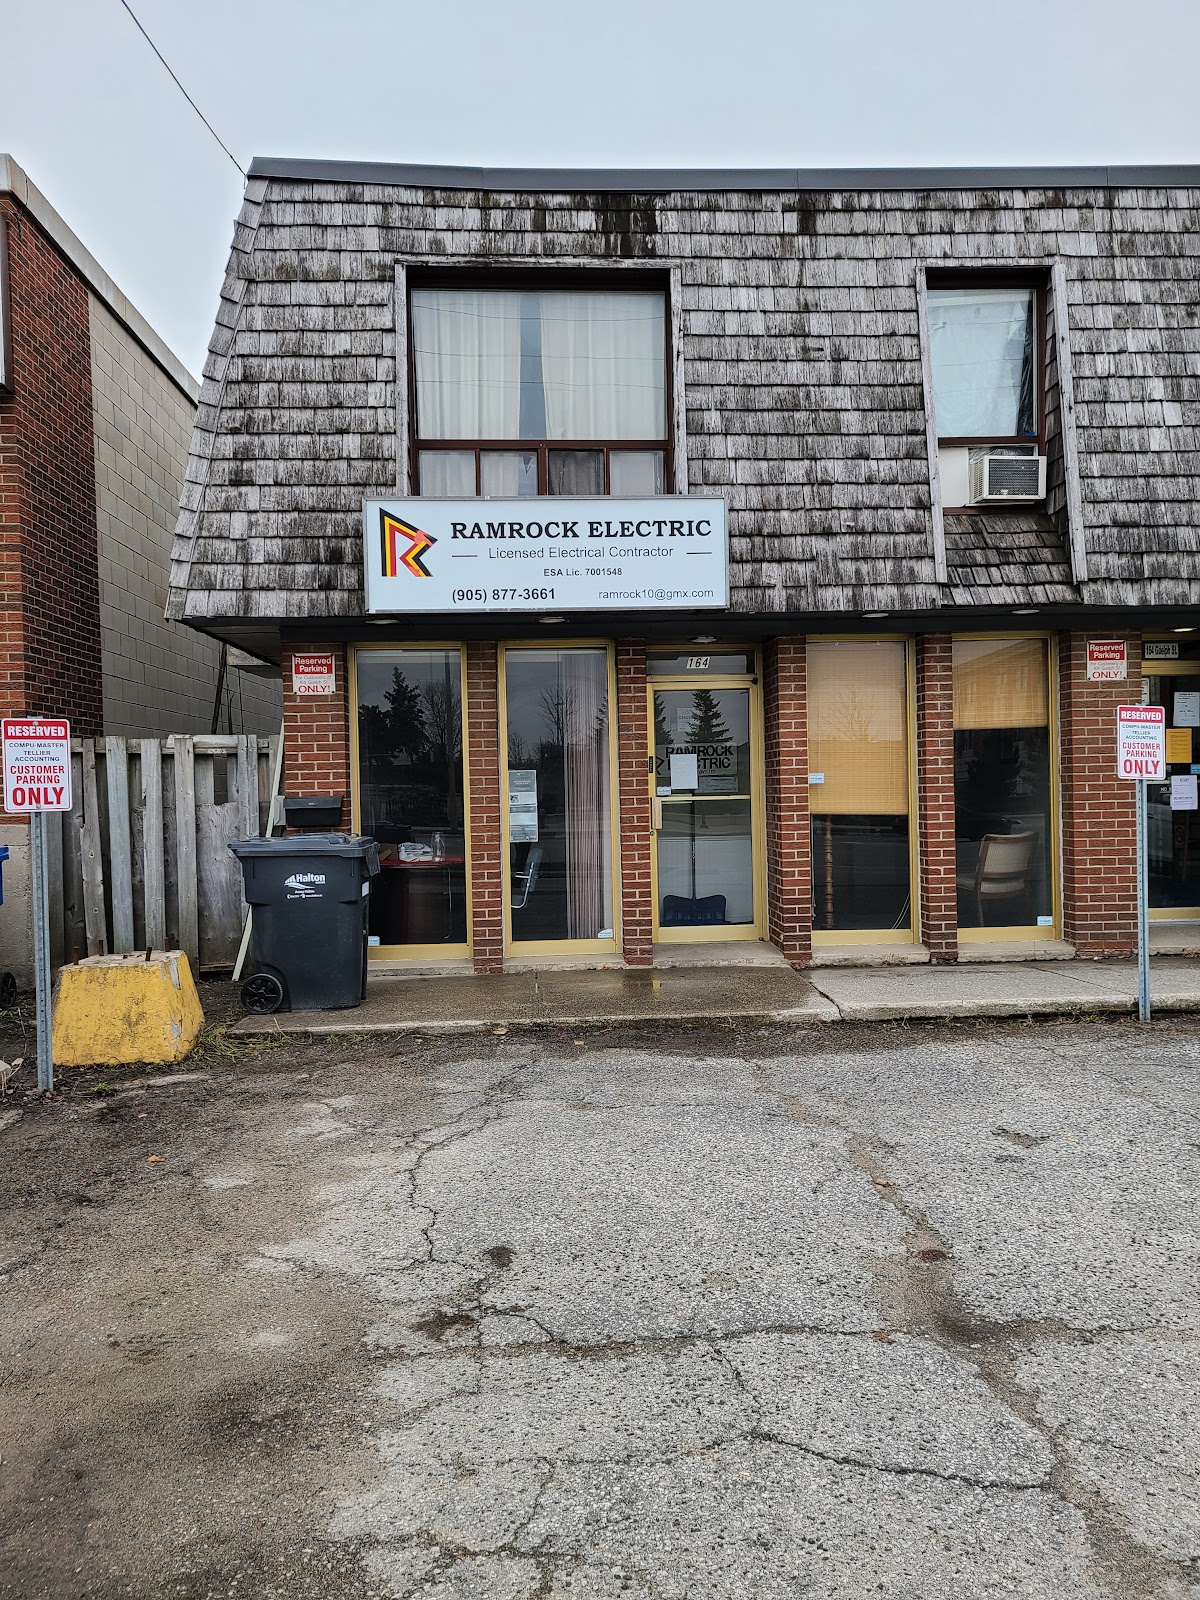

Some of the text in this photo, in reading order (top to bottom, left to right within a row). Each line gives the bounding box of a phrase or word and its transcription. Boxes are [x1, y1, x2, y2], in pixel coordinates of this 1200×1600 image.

[450, 520, 712, 539] RAMROCK ELECTRIC
[488, 546, 674, 559] Licensed Electrical Contractor
[543, 567, 623, 576] ESA Lic. 7001548
[452, 588, 555, 604] (905) 877-3661
[598, 588, 714, 601] ramrock10@gmx.com
[1093, 651, 1120, 659] Parking
[295, 657, 332, 665] Reserved
[688, 657, 709, 668] 164
[299, 665, 328, 673] Parking
[1092, 671, 1122, 679] ONLY!
[298, 685, 331, 693] ONLY!
[1121, 710, 1162, 720] RESERVED
[7, 725, 66, 737] RESERVED
[1122, 742, 1161, 750] CUSTOMER
[1126, 750, 1157, 758] PARKING
[10, 765, 65, 775] CUSTOMER
[1123, 759, 1160, 775] ONLY
[16, 775, 60, 785] PARKING
[12, 786, 65, 807] ONLY
[296, 873, 325, 882] Halton
